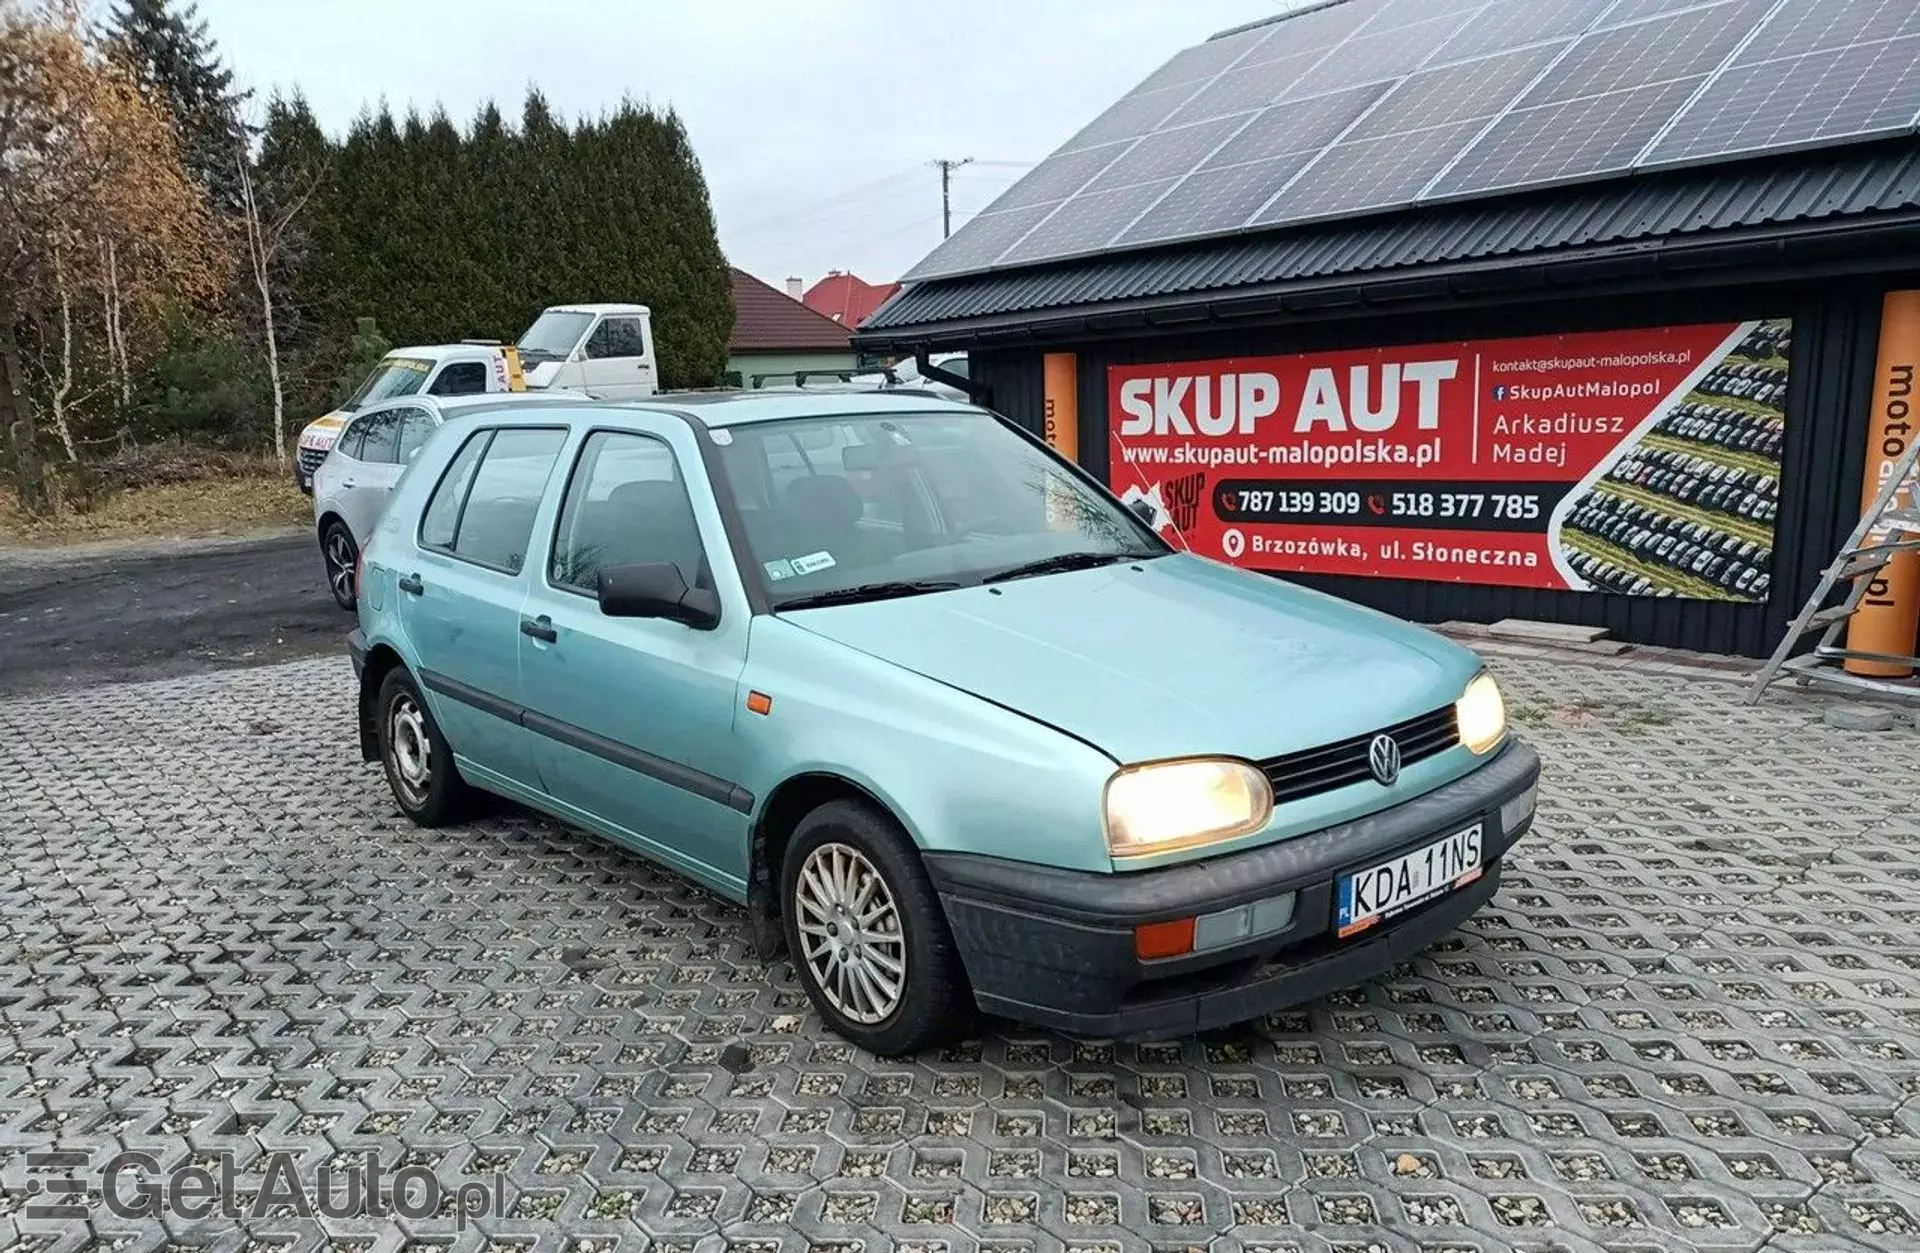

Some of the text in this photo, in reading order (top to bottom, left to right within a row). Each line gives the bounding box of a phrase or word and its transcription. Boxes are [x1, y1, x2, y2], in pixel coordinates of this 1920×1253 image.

[1492, 350, 1691, 373] kontakt@skupaut-malopolska.pl
[1120, 360, 1458, 436] SKUP AUT
[1509, 379, 1660, 401] SkupAutMalopol
[1493, 413, 1624, 435] Arkadiusz
[1123, 437, 1441, 468] www.skupaut-malopolska.pl
[1493, 442, 1566, 467] Madej
[1165, 472, 1205, 510] SKUP
[1239, 491, 1360, 514] 787 139 309
[1171, 504, 1198, 534] AUT
[1392, 493, 1539, 519] 518 377 785
[1252, 535, 1537, 567] Brzozówka, ul. Słoneczna
[1354, 859, 1411, 917] KDA
[1425, 829, 1479, 886] 11NS
